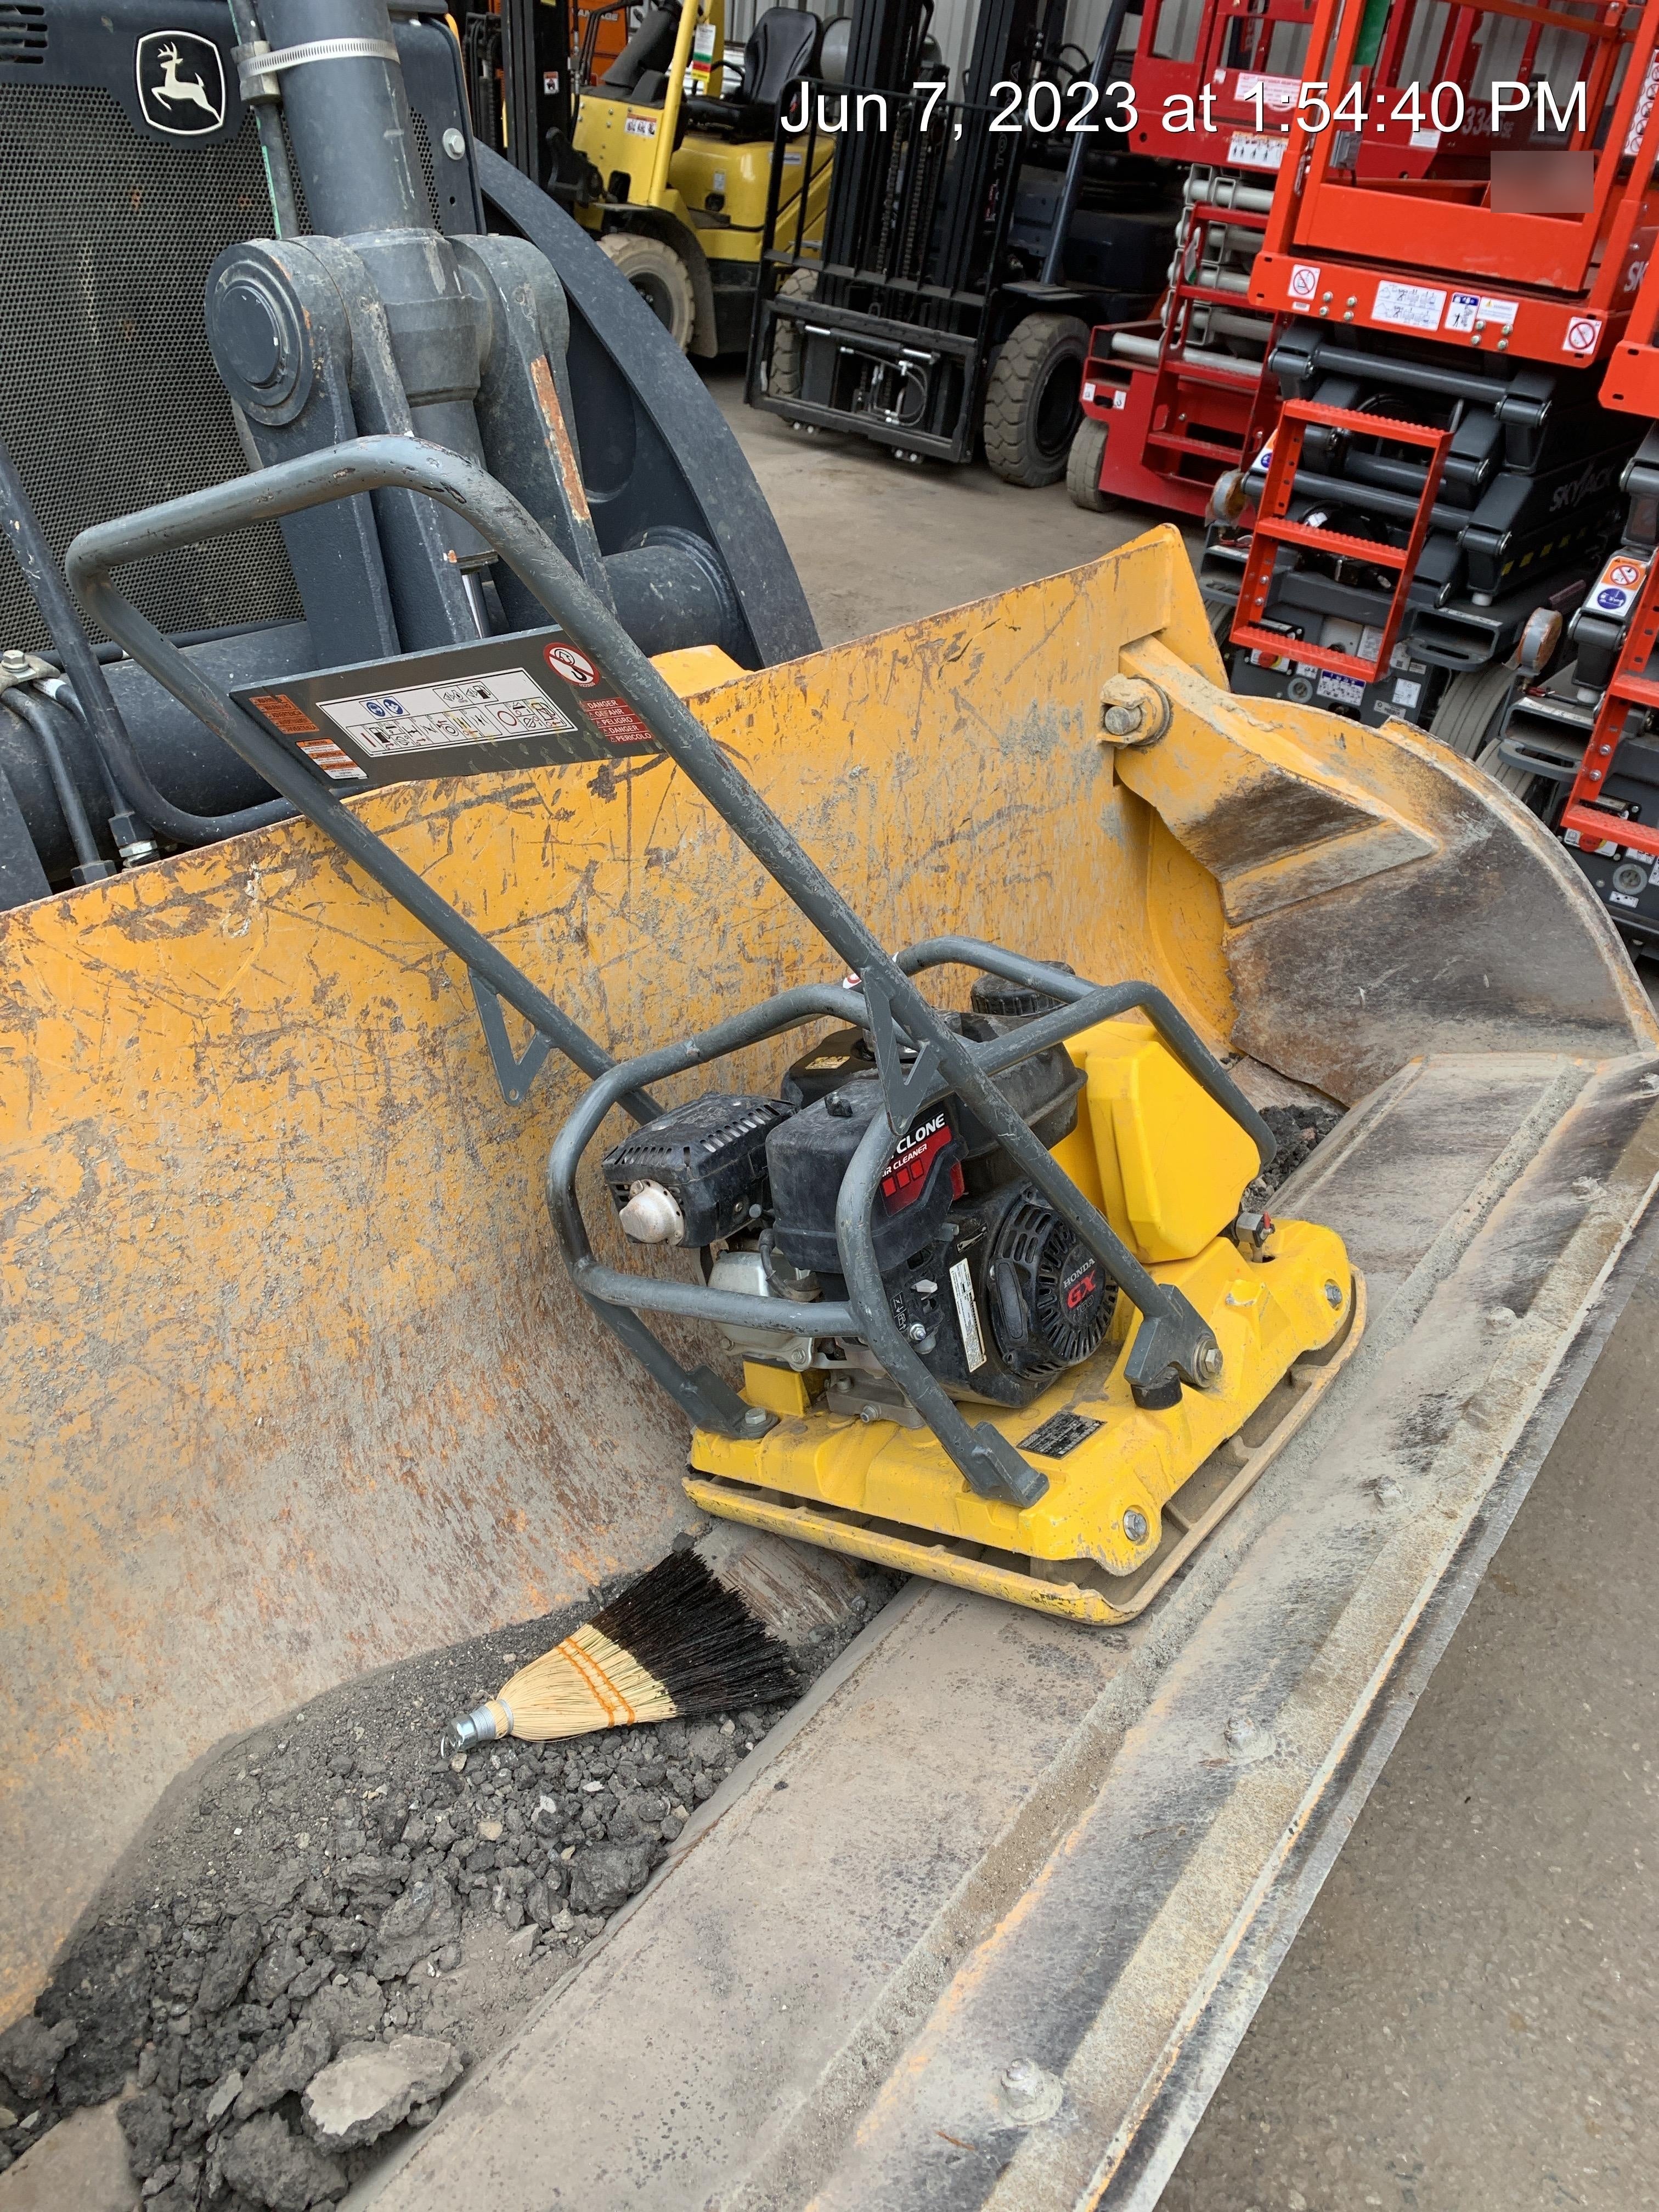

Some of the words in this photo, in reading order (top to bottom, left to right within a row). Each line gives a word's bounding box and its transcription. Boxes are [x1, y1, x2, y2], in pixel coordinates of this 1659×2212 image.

[587, 699, 618, 709] DANGER
[602, 716, 633, 726] PELIGRO
[608, 725, 640, 734] DANGER
[616, 733, 652, 742] PERICOLO
[892, 1113, 945, 1158] CLONE
[893, 1143, 928, 1170] CLEANER
[1063, 1258, 1096, 1289] HONDA
[1066, 1269, 1097, 1308] GX
[1076, 1295, 1094, 1317] 160
